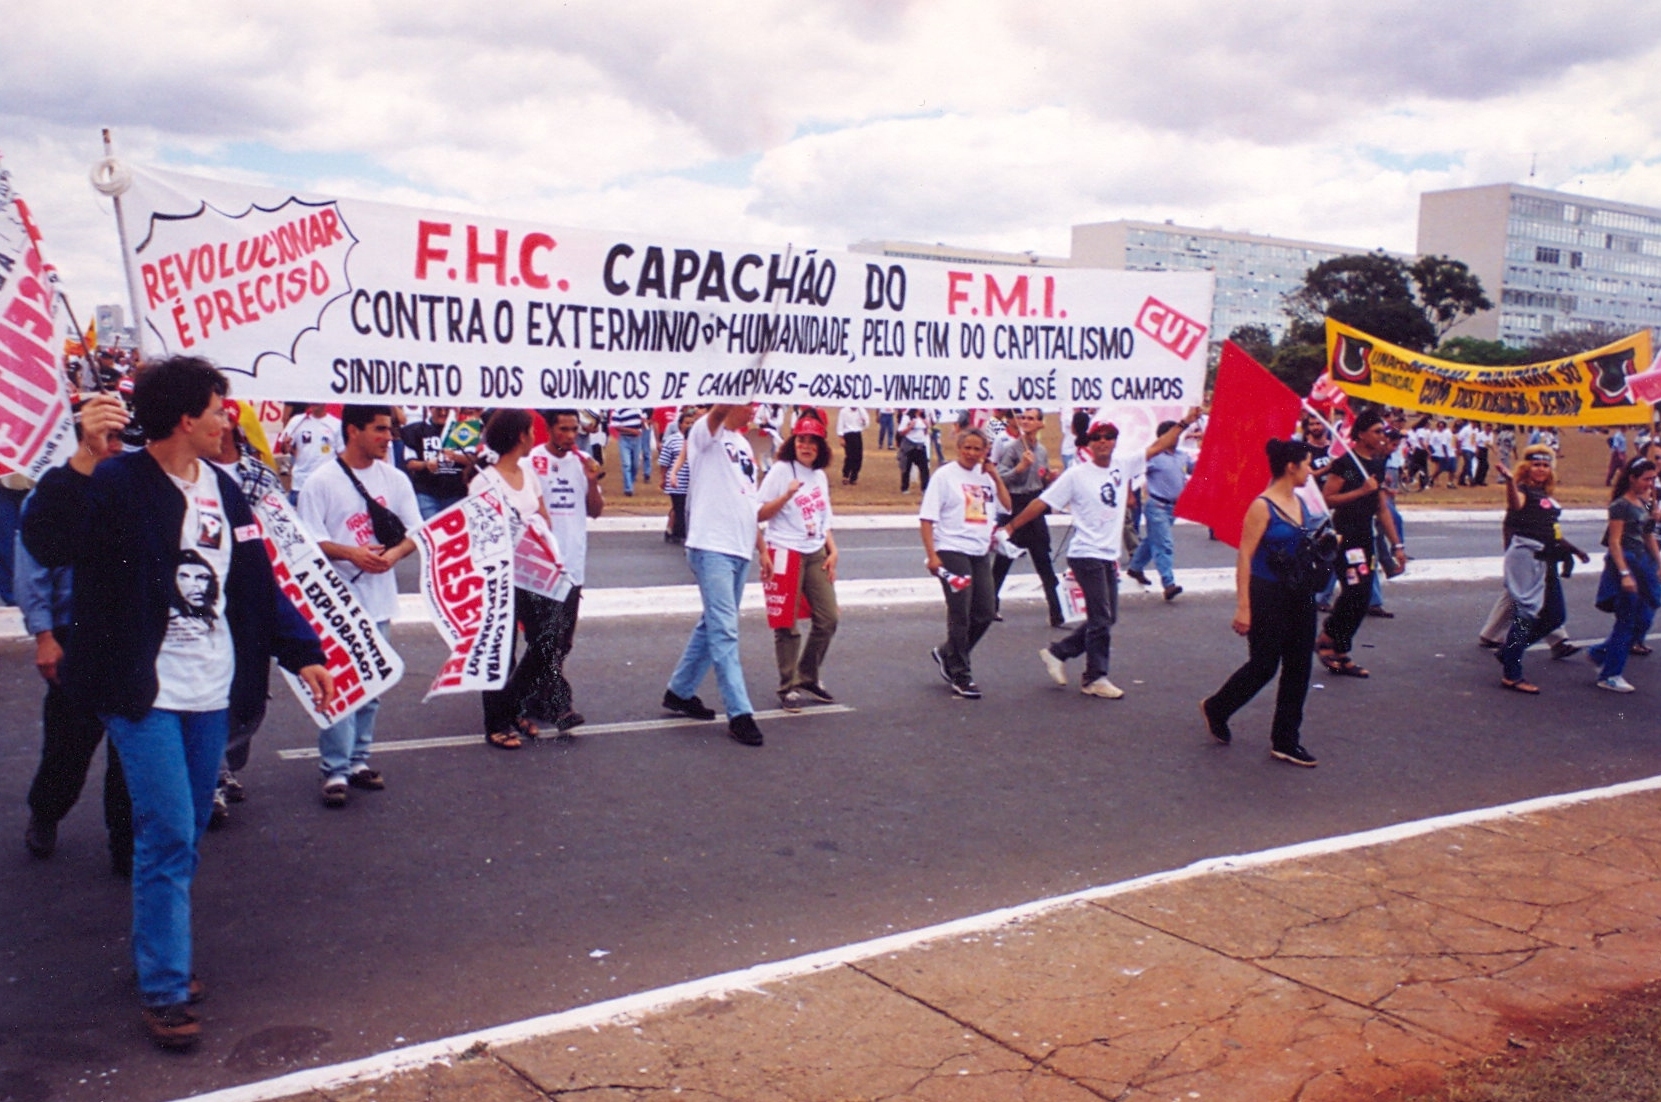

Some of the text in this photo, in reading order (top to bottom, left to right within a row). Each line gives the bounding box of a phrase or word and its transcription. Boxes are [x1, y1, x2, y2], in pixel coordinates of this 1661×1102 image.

[141, 208, 343, 310] REVOLUCIONAR
[415, 220, 1067, 318] F.H.C. CAPACHÃO DO F.M.I.
[172, 260, 330, 348] É PRECISO
[351, 289, 1134, 363] CONTRA O EXTERMINIO DA HUMANIDADE, PELO FIM DO CAPITALISMO
[1141, 305, 1202, 353] CUT
[330, 358, 462, 397] SINDICATO
[480, 365, 523, 398] DOS
[540, 360, 650, 401] QUÍMICOS
[661, 372, 689, 400] DE
[958, 376, 968, 400] E
[977, 376, 993, 400] S.
[1009, 369, 1056, 401] JOSÉ
[1072, 377, 1102, 400] DOS
[1112, 377, 1183, 400] CAMPOS
[483, 565, 497, 575] A
[500, 572, 509, 609] LUTA
[295, 570, 309, 585] A
[304, 582, 373, 682] EXPLORAÇÃO?
[312, 557, 325, 570] A
[324, 570, 352, 606] LUTA
[358, 619, 393, 681] CONTRA
[486, 625, 505, 682] CONTRA
